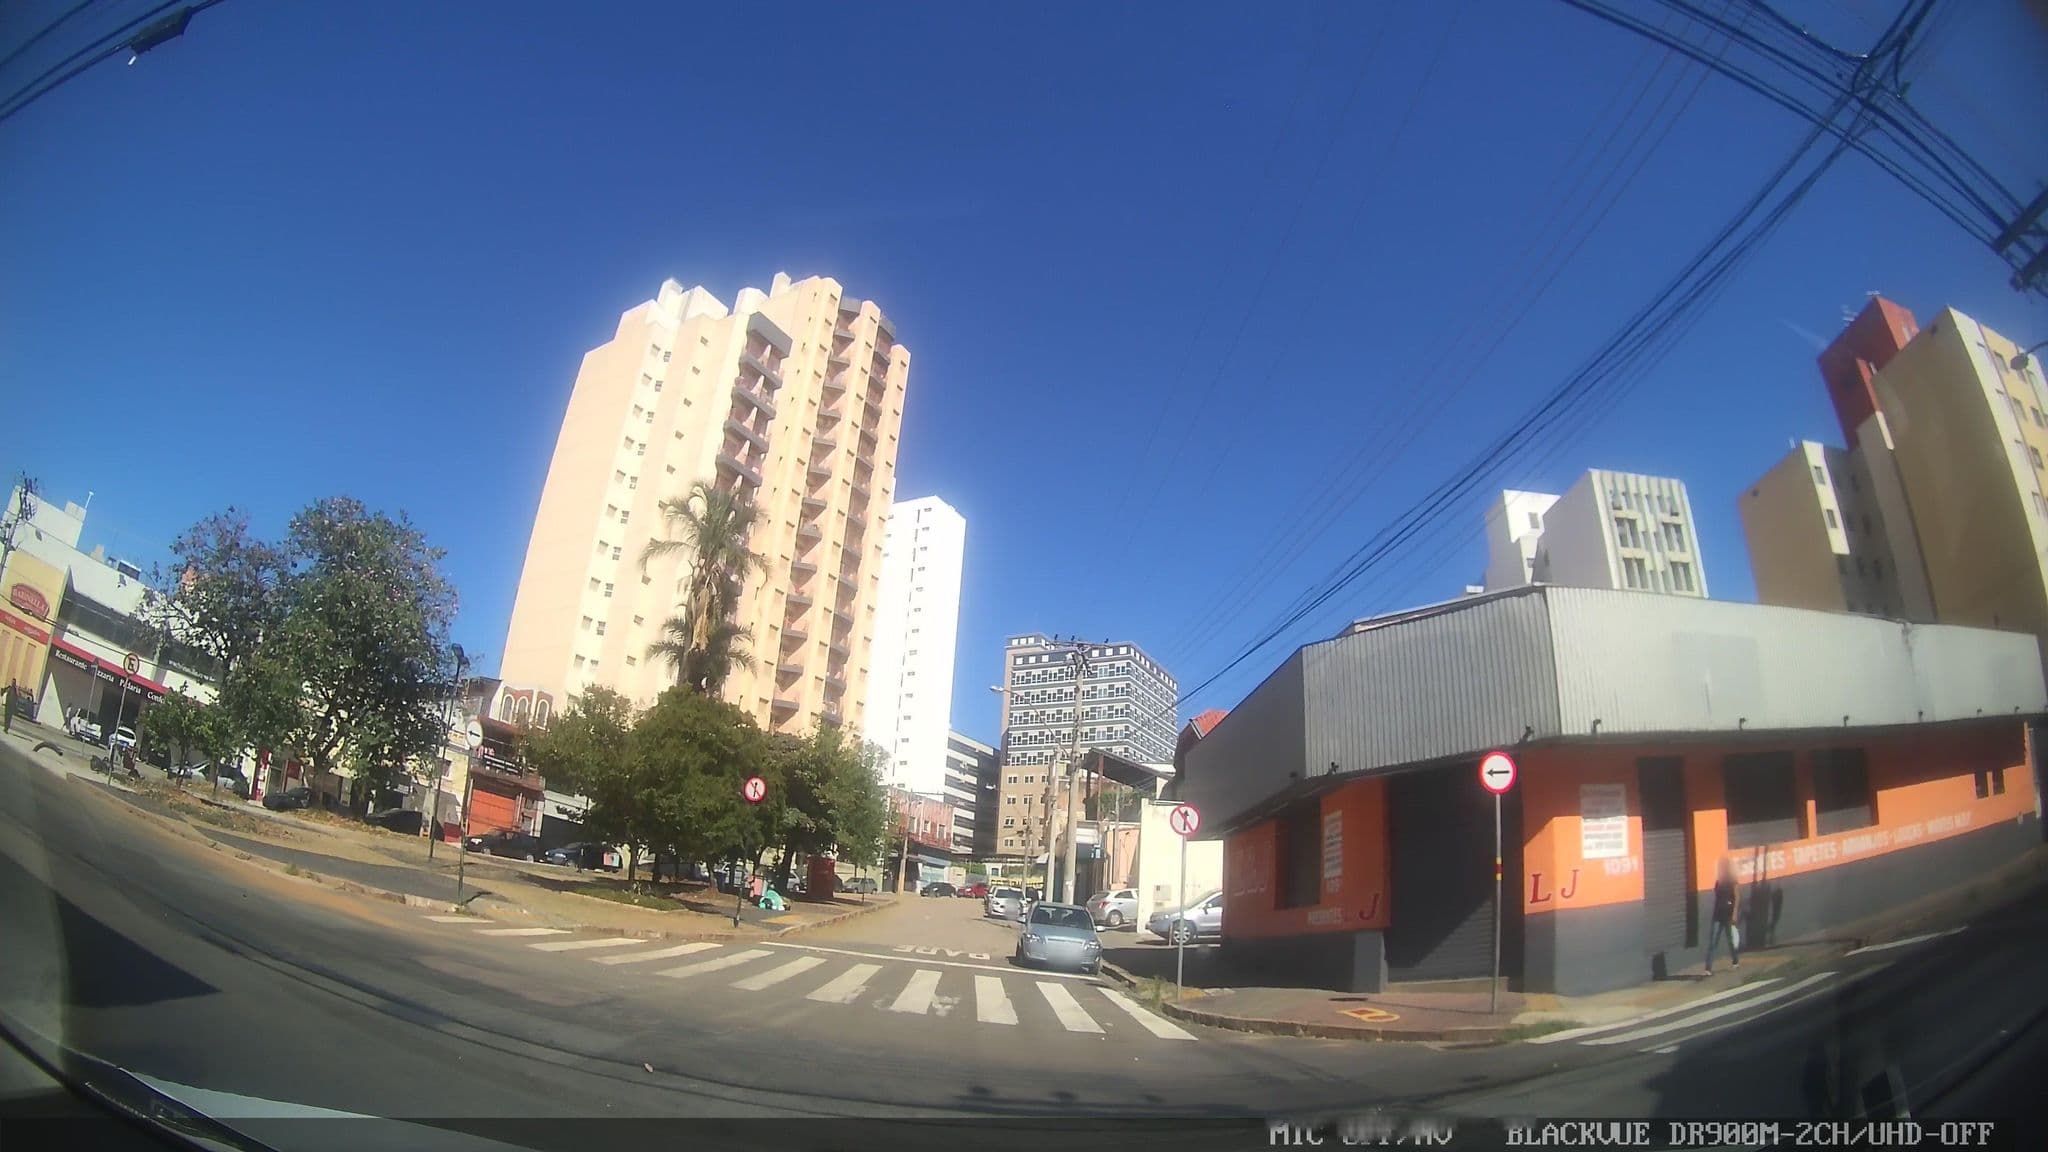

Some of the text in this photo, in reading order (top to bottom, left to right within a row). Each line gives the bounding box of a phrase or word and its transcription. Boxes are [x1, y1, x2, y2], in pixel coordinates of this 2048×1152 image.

[55, 649, 88, 670] Restaurante
[1529, 868, 1579, 904] L J
[892, 944, 991, 960] PARE
